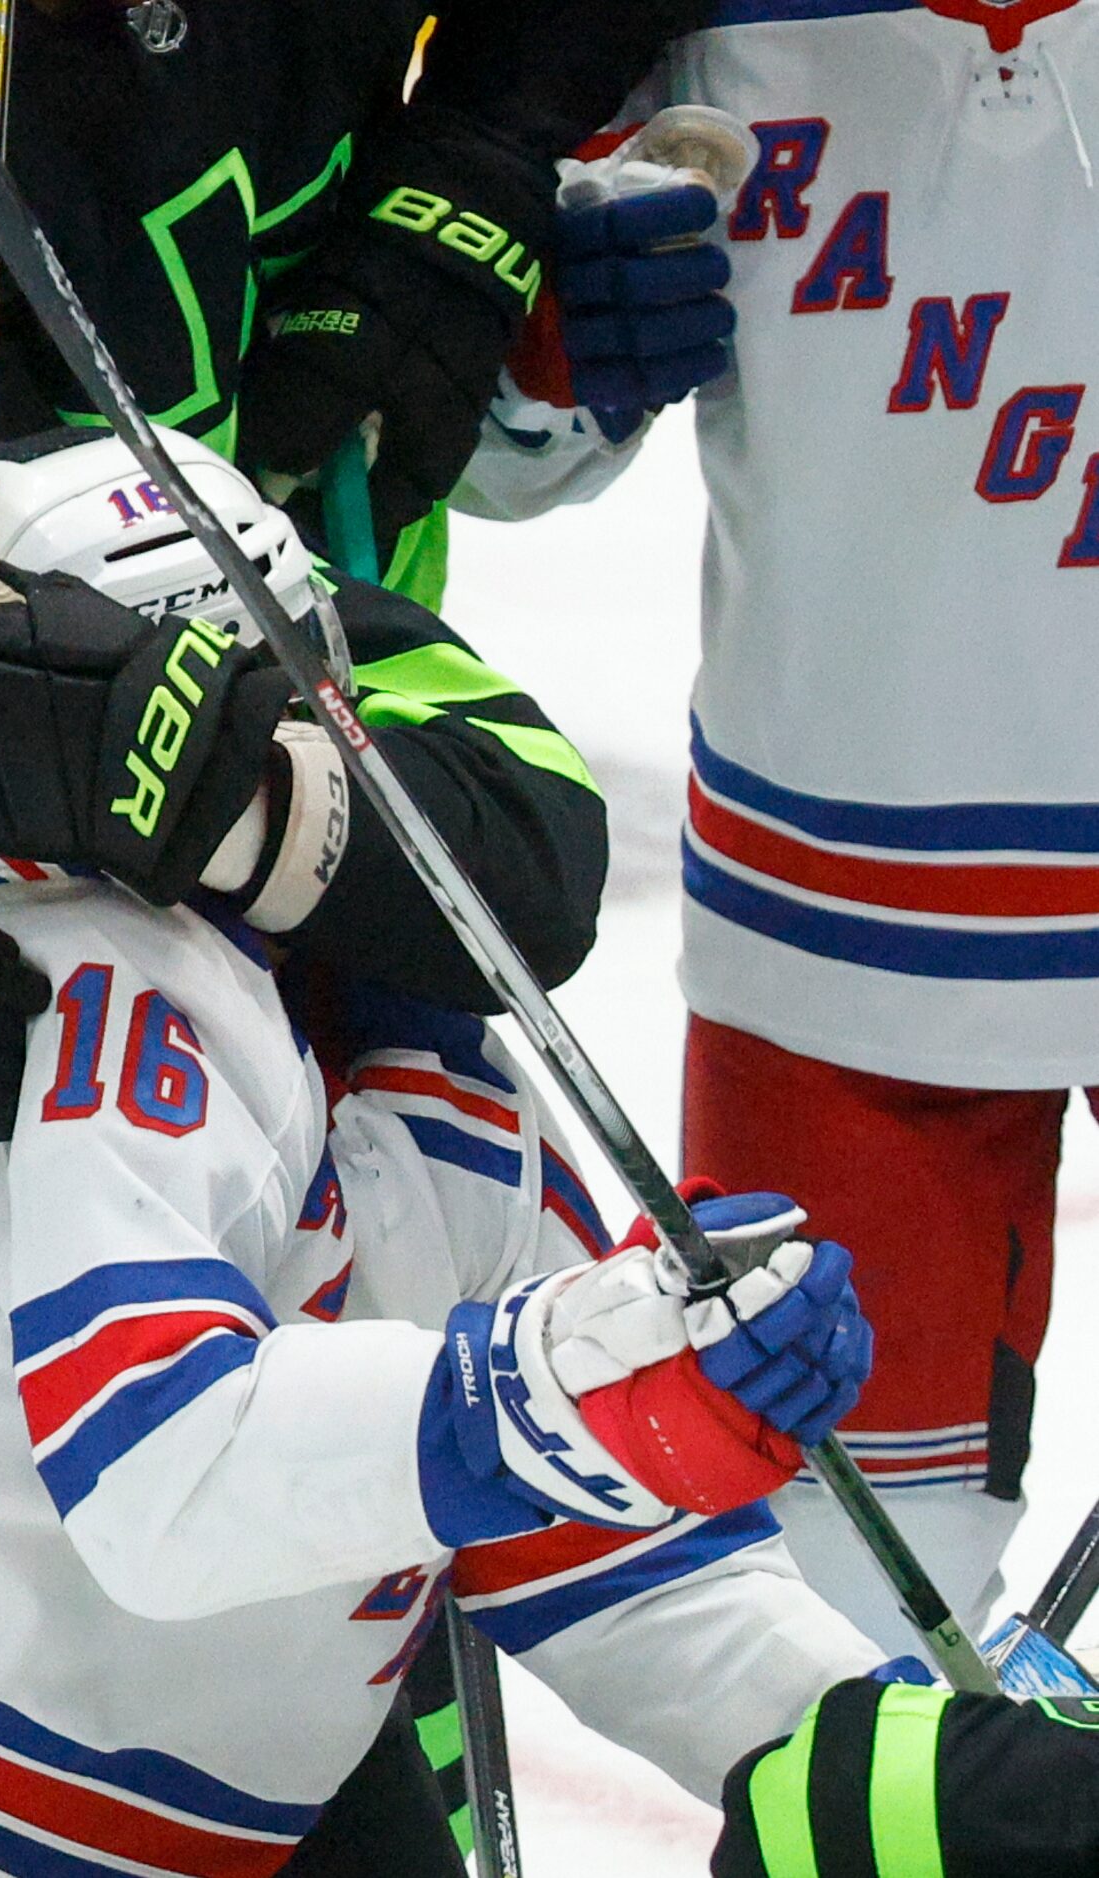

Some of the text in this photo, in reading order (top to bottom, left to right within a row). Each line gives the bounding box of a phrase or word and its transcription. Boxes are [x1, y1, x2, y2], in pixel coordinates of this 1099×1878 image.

[317, 686, 368, 749] CCM
[313, 769, 346, 886] CCM
[41, 962, 209, 1139] 16
[455, 1332, 481, 1409] TROCH
